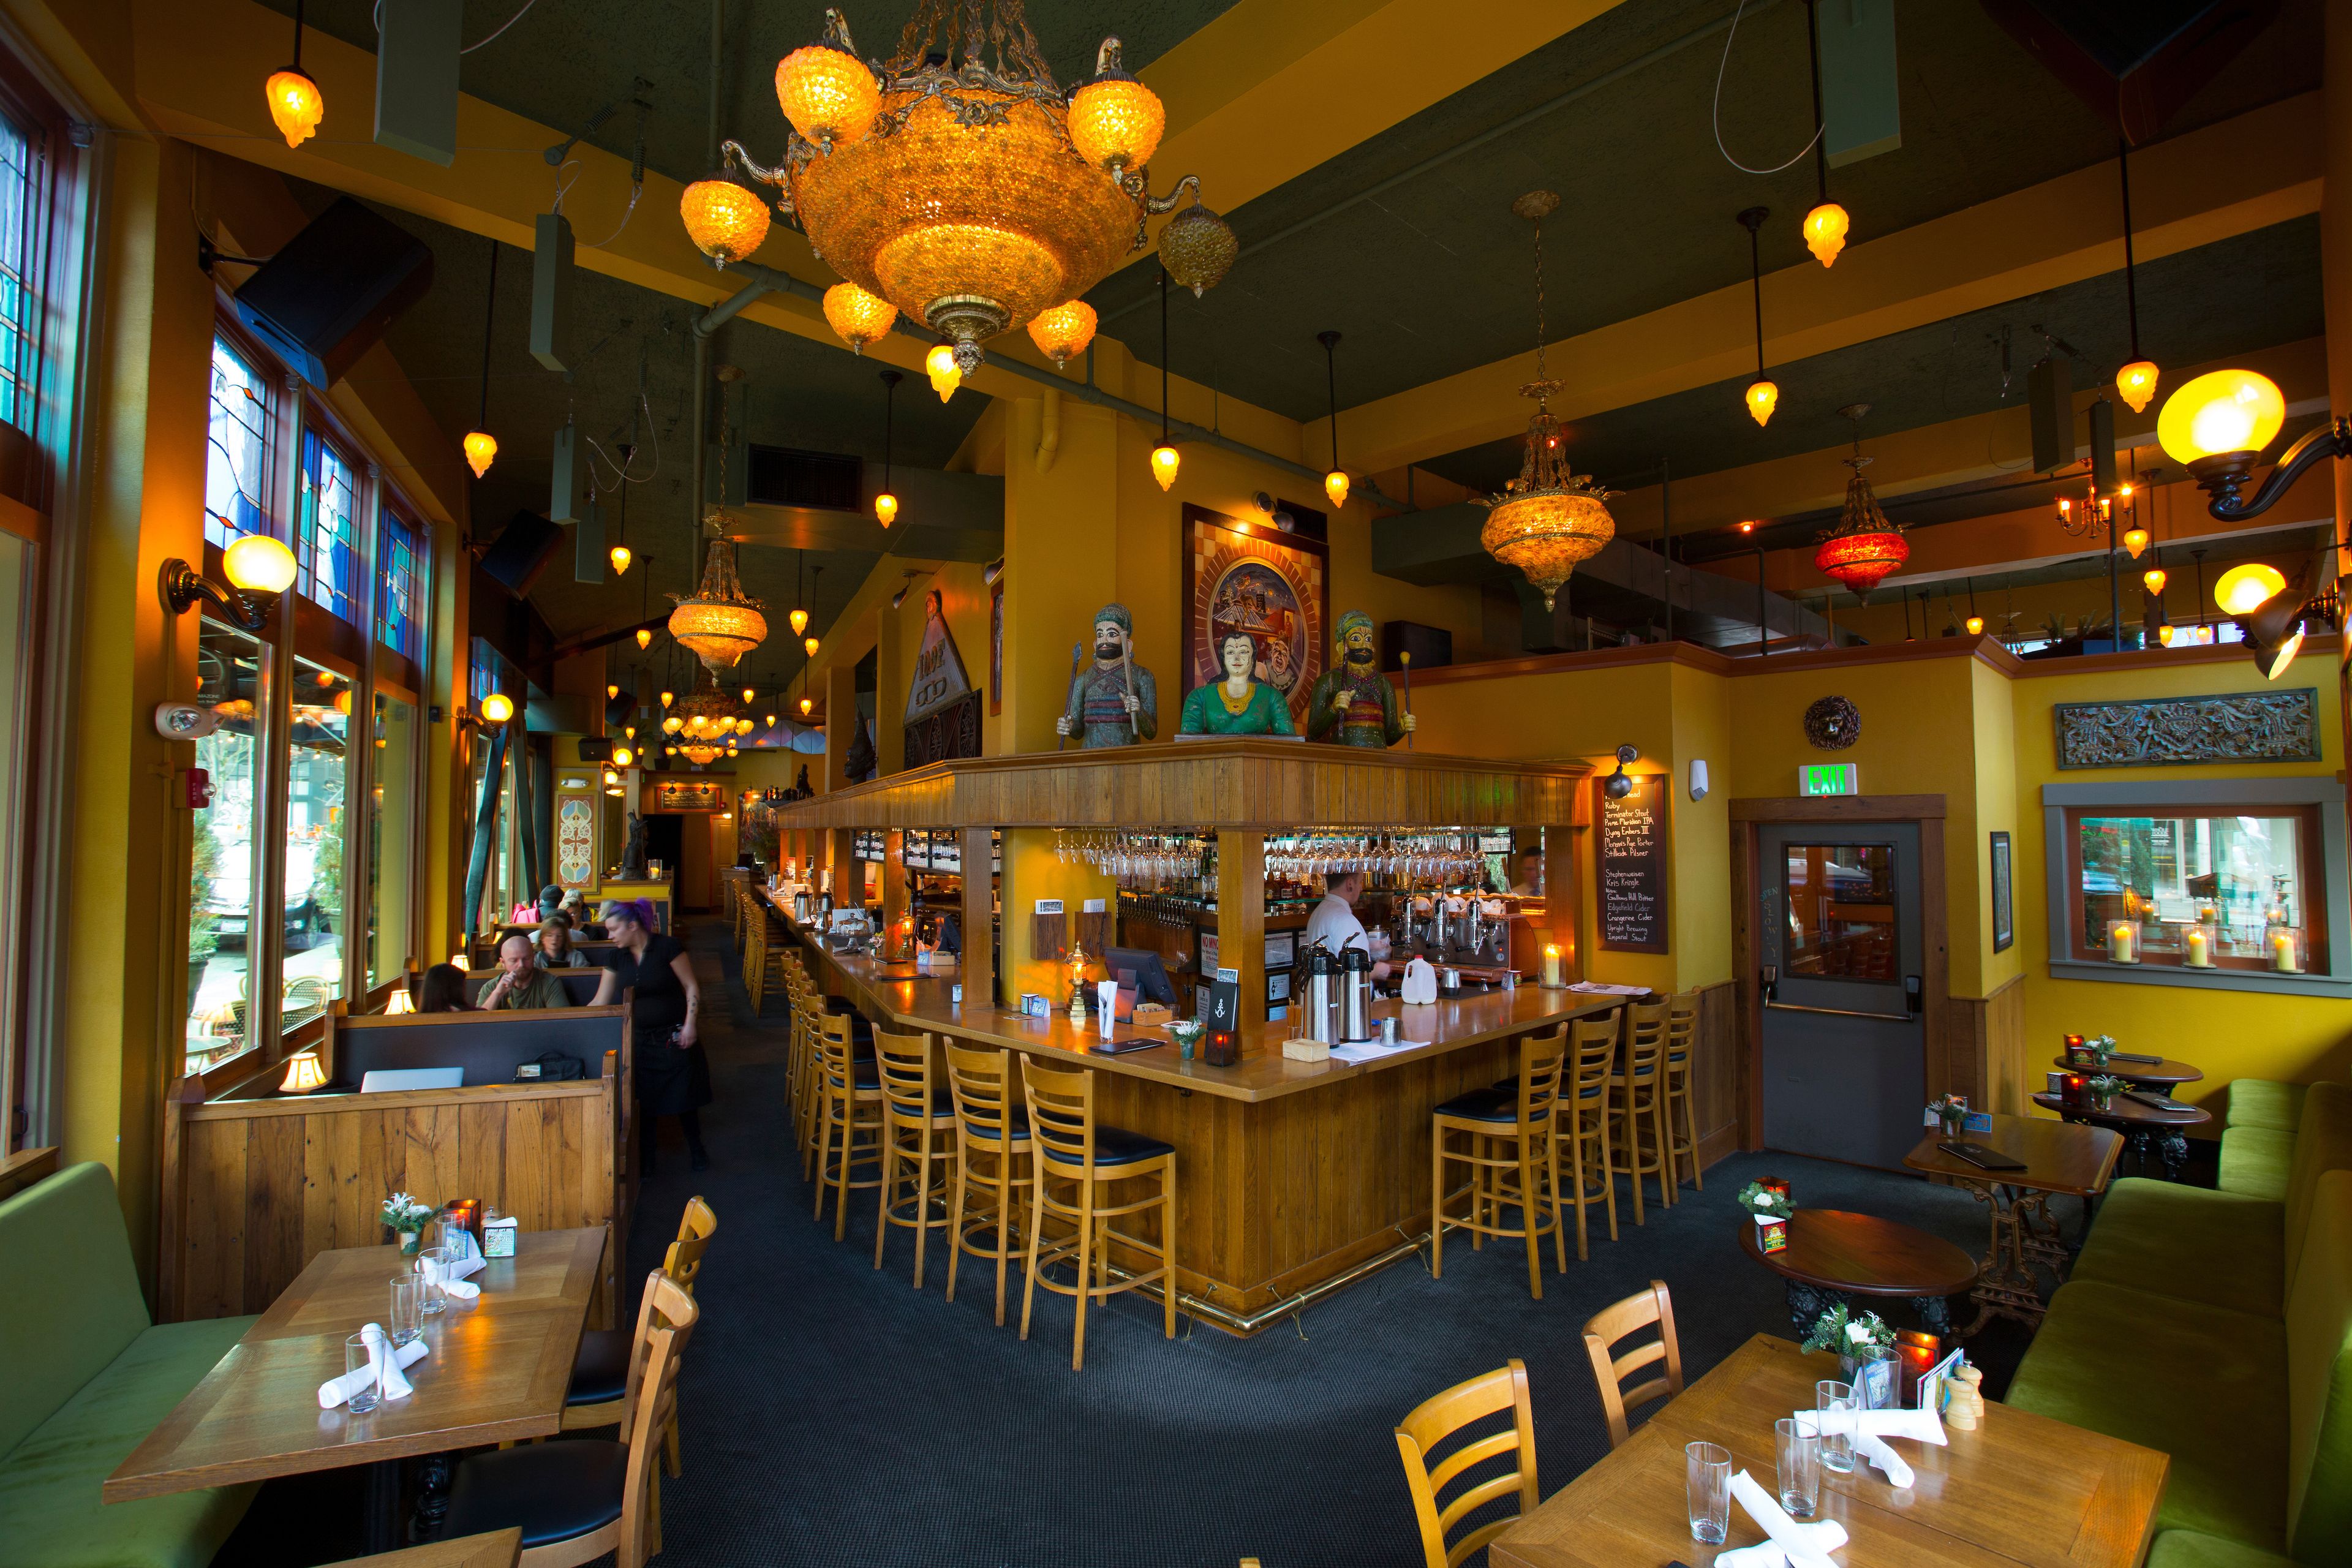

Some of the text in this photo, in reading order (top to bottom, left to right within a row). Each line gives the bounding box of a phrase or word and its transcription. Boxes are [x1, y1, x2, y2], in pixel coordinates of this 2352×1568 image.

[1808, 765, 1847, 794] EXIT
[1605, 801, 1620, 811] Ruby
[1605, 809, 1649, 818] Terminator Stout
[1605, 826, 1649, 838] Dying Embers III
[1627, 837, 1636, 847] Rye
[1637, 837, 1653, 846] Porter
[1629, 847, 1648, 856] Pilsner
[1621, 878, 1640, 888] Kringle
[1628, 892, 1637, 901] Hill
[1760, 886, 1778, 902] OPEN
[1608, 902, 1651, 913] Edgefield Cider
[1607, 913, 1635, 924] Crangerine
[1607, 924, 1648, 935] Upright Brewing
[1202, 936, 1208, 947] NO
[1608, 933, 1628, 941] Imperial
